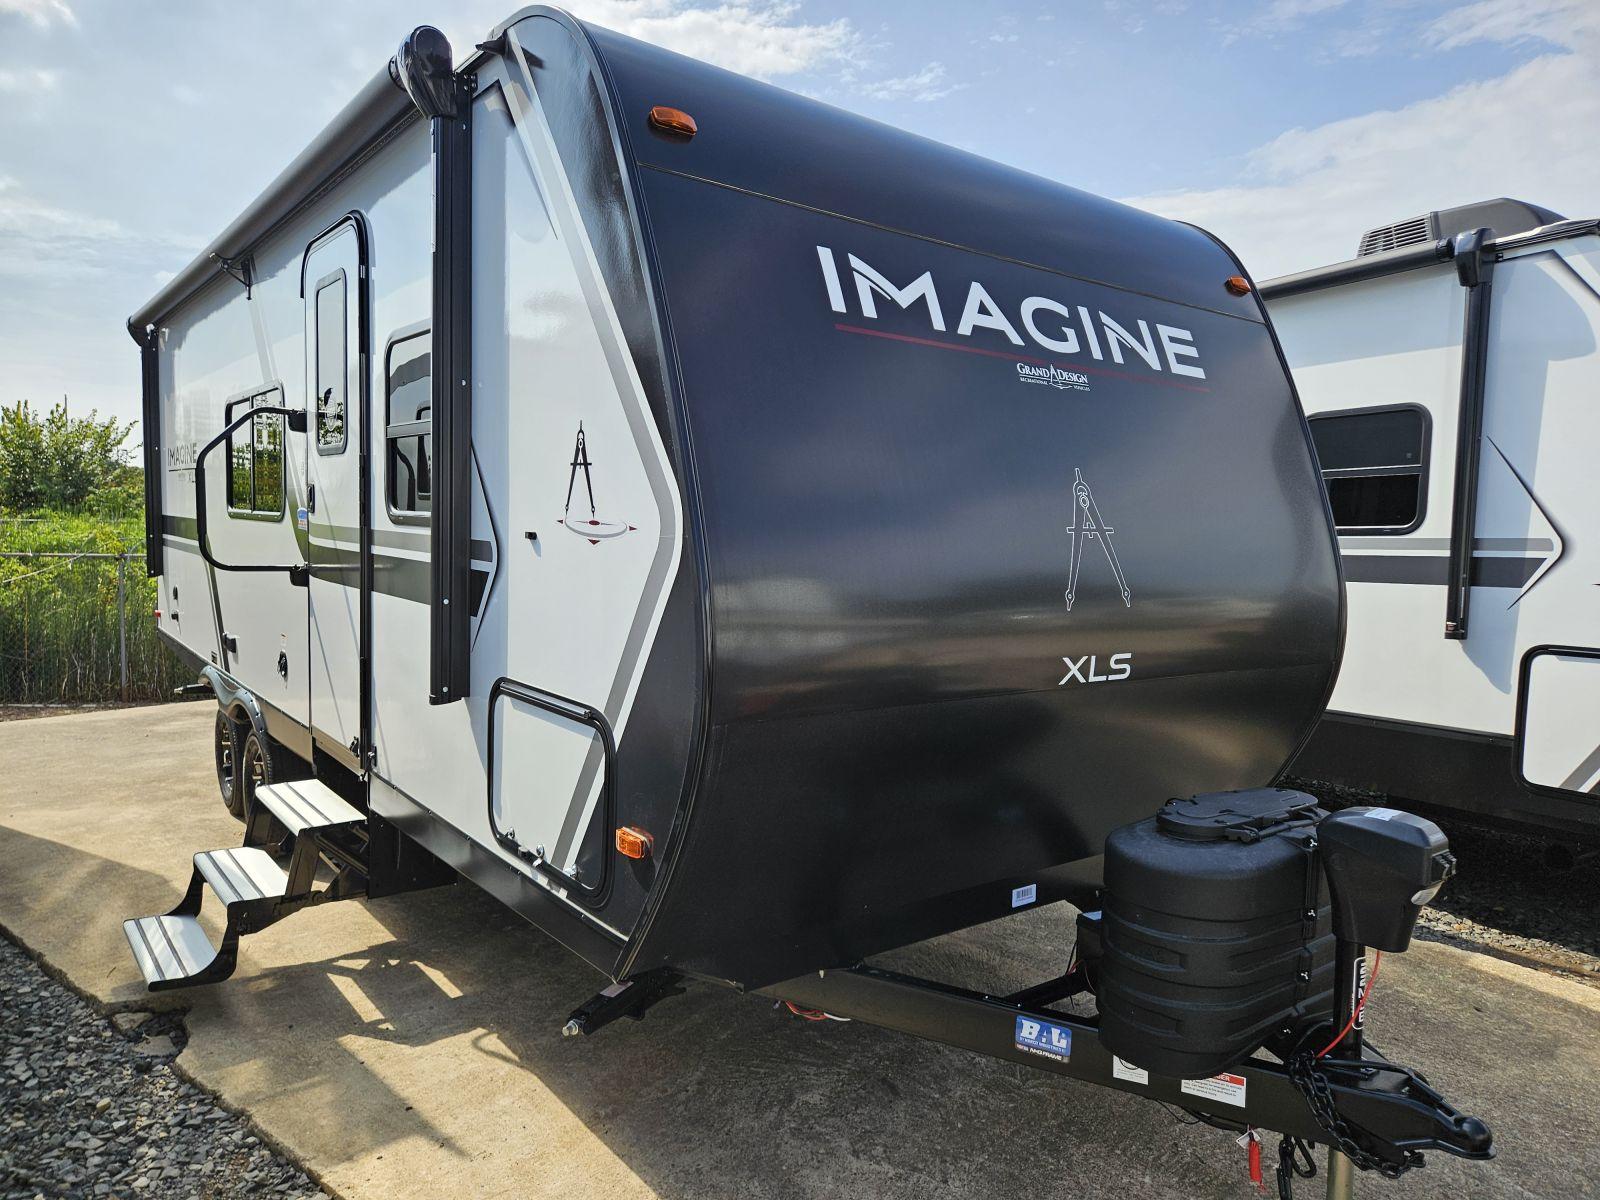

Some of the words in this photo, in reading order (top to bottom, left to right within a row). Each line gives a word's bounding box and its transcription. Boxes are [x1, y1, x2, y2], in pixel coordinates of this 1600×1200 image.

[816, 245, 1206, 380] IMAGINE
[1016, 362, 1050, 378] GRAND
[1057, 369, 1089, 384] DESIGN
[167, 442, 198, 467] IMAGINE
[1058, 652, 1132, 686] XLS
